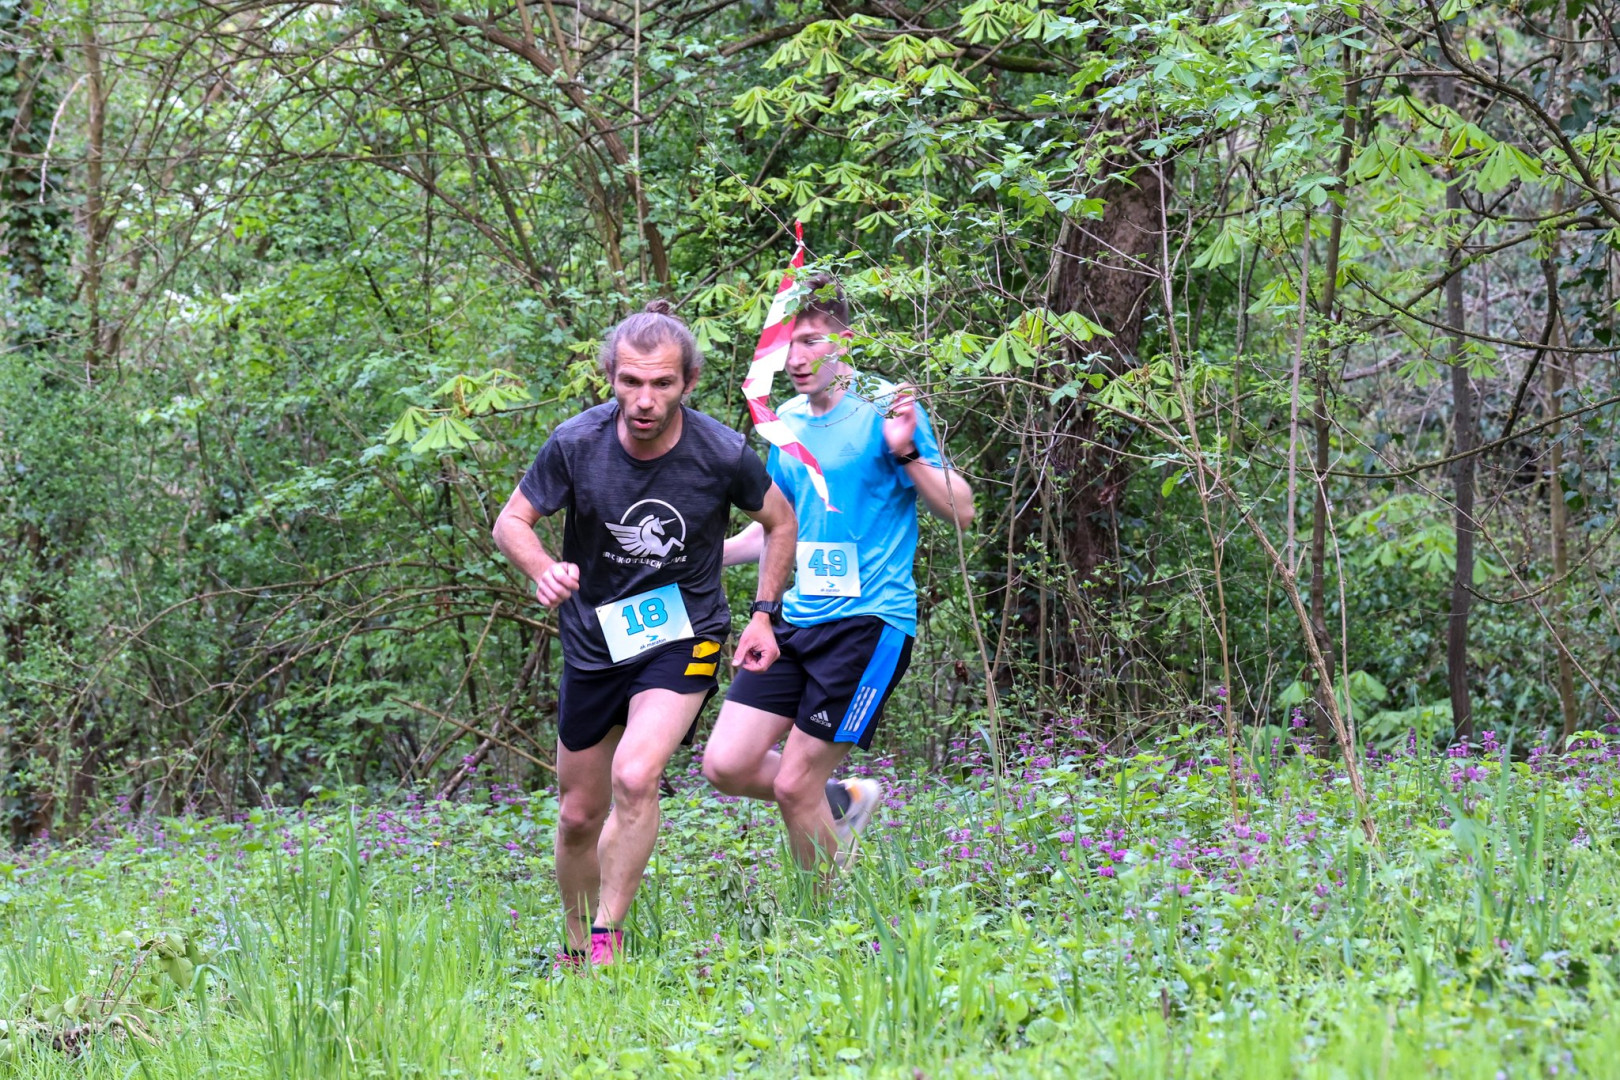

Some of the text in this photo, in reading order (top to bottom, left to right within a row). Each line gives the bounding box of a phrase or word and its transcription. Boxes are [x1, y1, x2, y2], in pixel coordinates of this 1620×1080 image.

[808, 548, 848, 577] 49
[621, 597, 669, 636] 18
[646, 637, 667, 648] maraton
